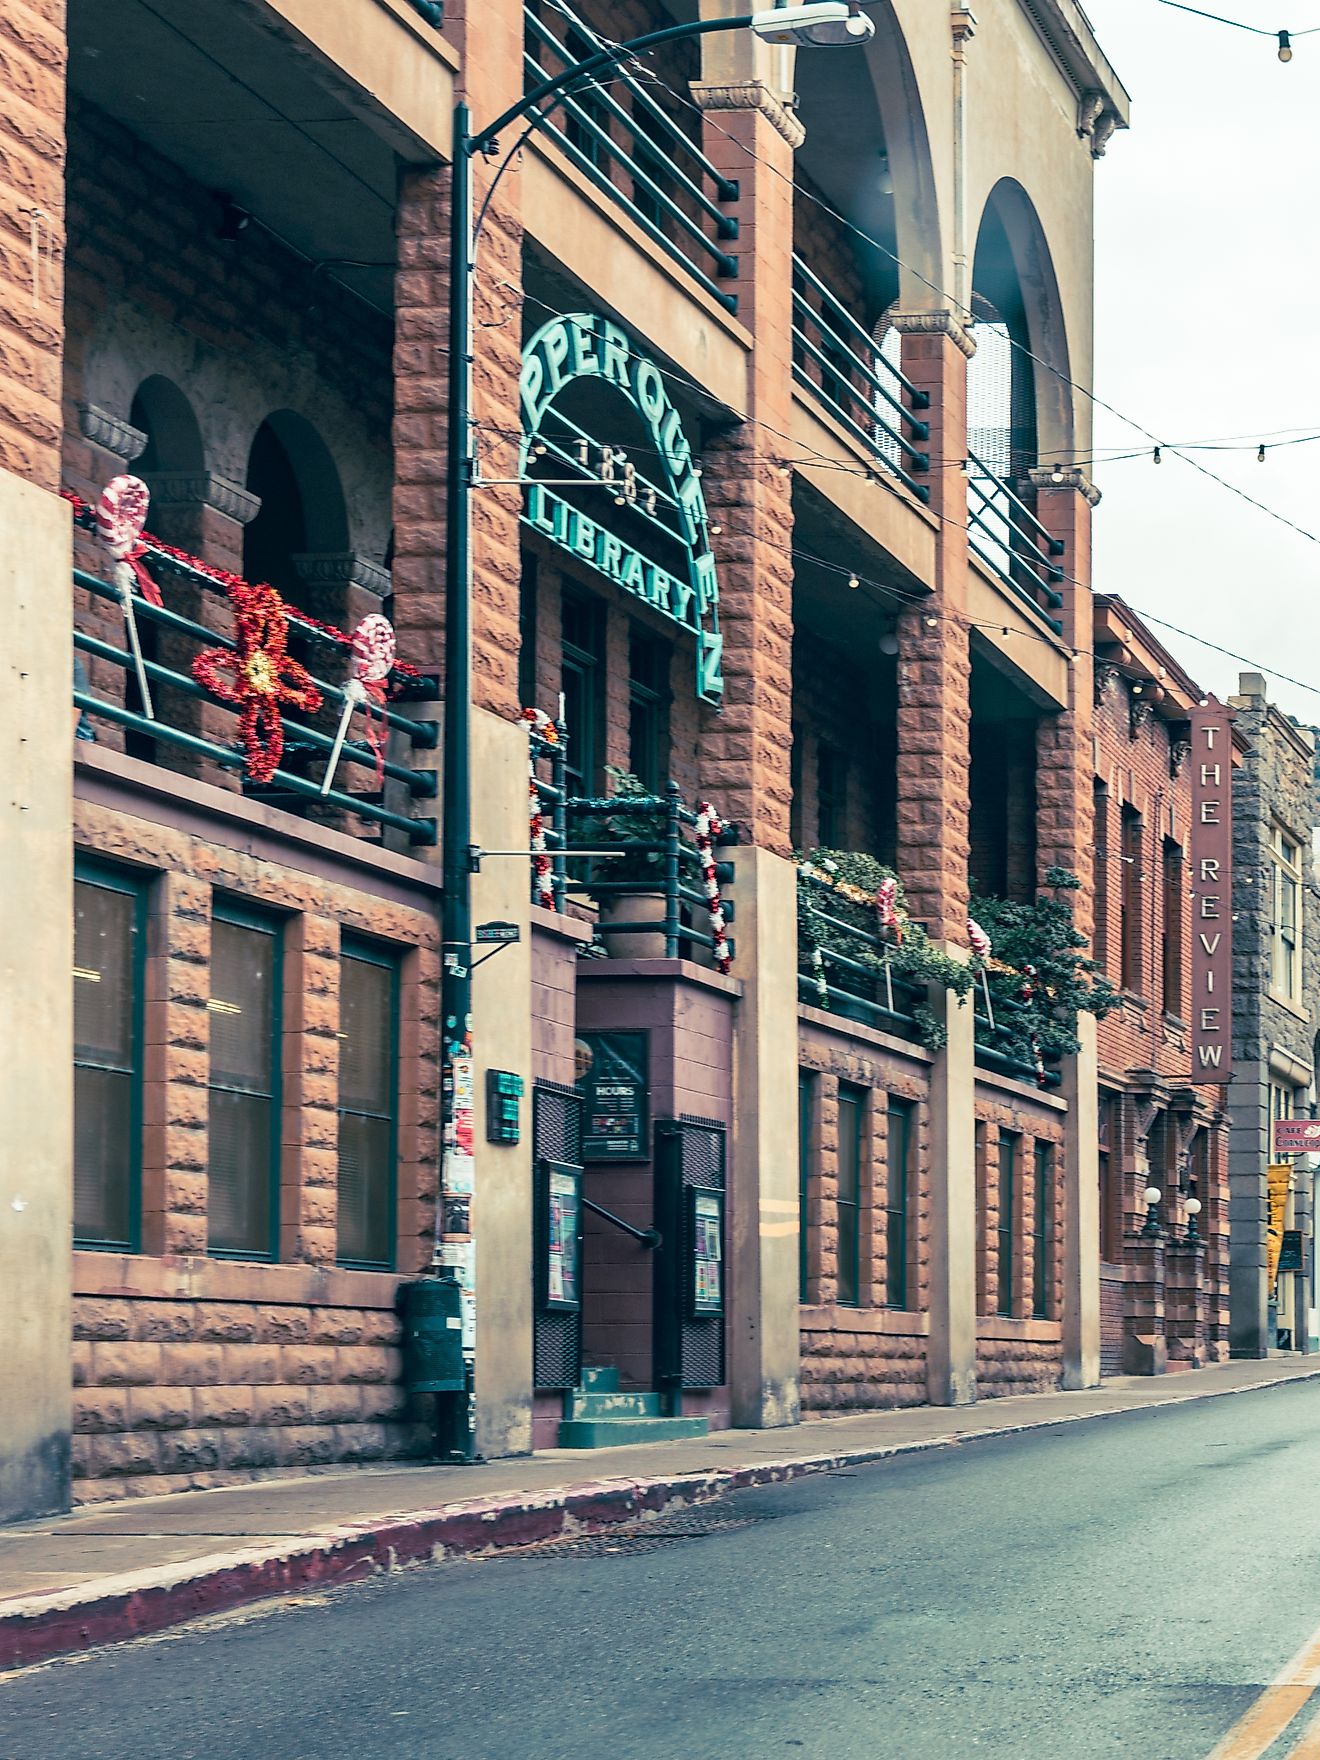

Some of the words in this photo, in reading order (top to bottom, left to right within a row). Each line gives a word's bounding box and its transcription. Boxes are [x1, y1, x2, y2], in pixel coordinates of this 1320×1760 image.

[530, 484, 695, 622] LIBRARY
[1200, 726, 1221, 824] THE
[1199, 858, 1223, 1069] REVIEW
[596, 1086, 635, 1096] HOURS
